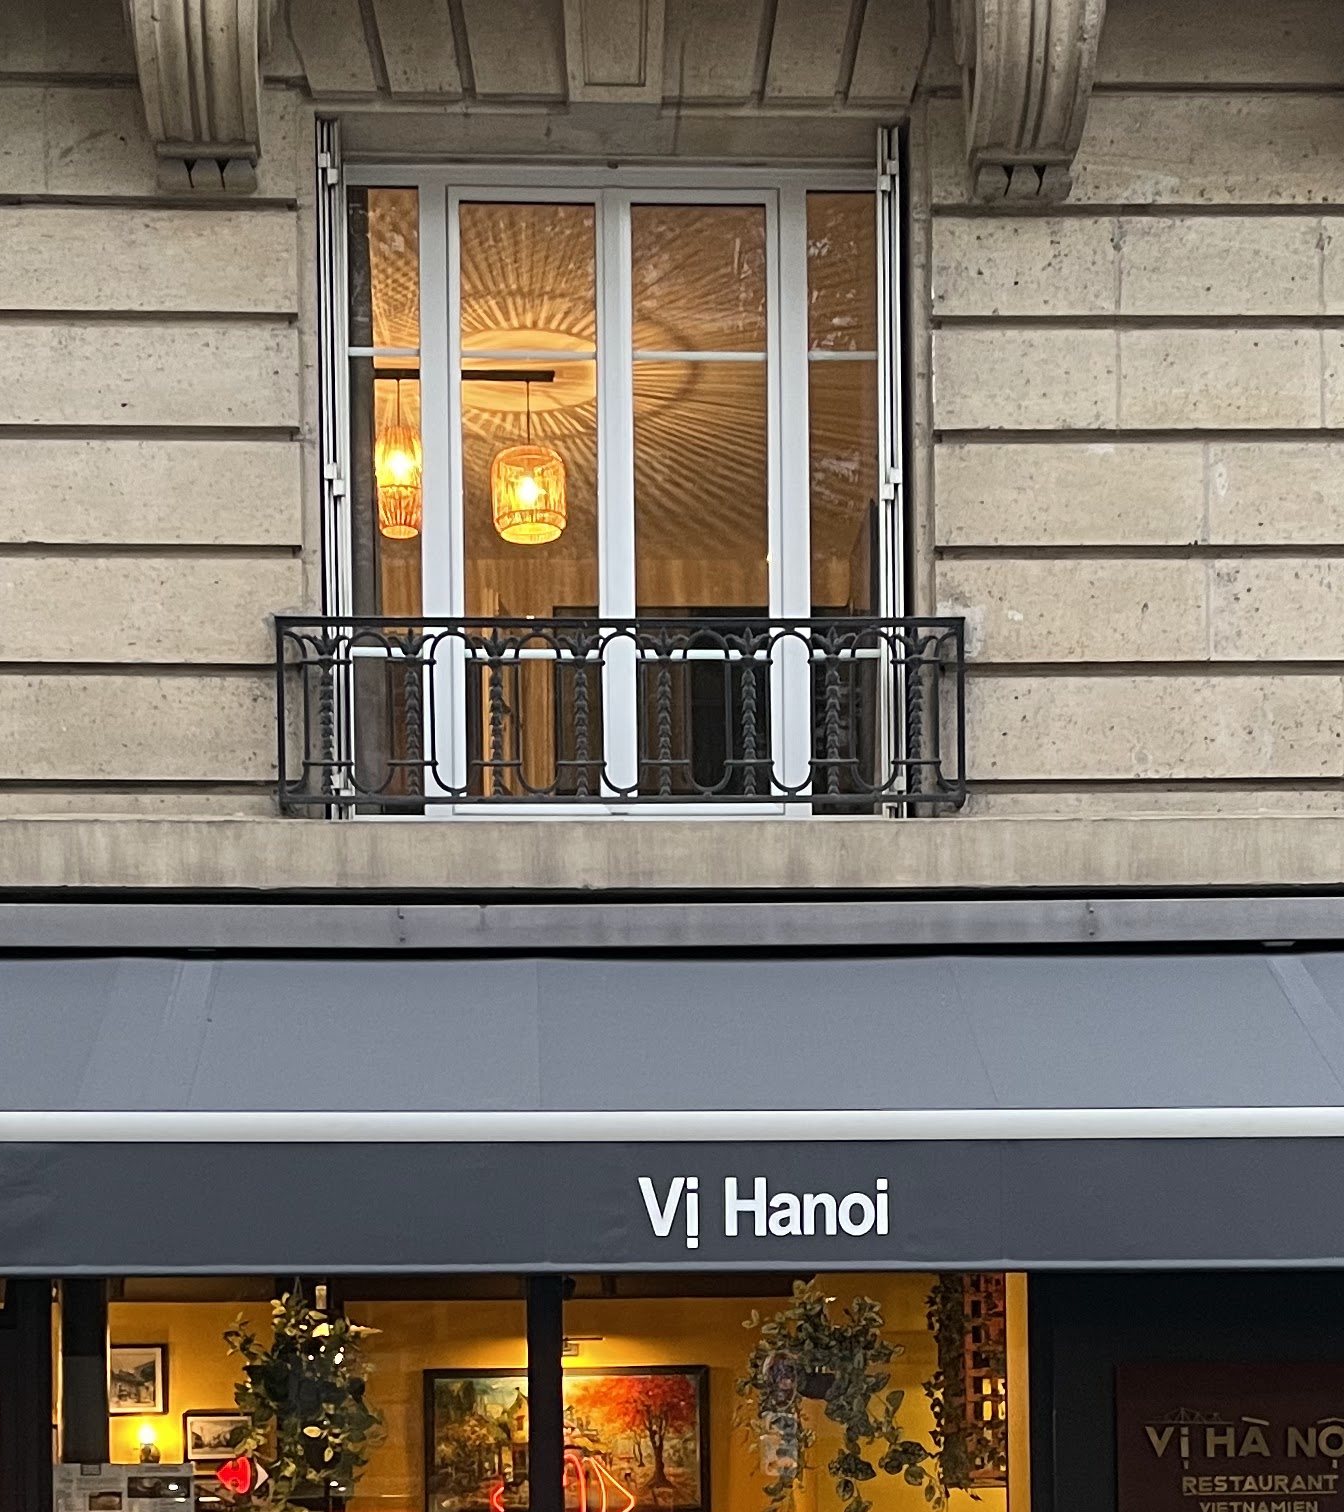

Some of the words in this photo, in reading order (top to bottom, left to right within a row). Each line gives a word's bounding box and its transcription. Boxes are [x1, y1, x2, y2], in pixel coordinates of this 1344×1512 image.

[637, 1176, 699, 1249] Vị
[724, 1176, 889, 1237] Hanoi
[1206, 1416, 1270, 1458] HÀ
[1182, 1474, 1339, 1494] RESTAURANT
